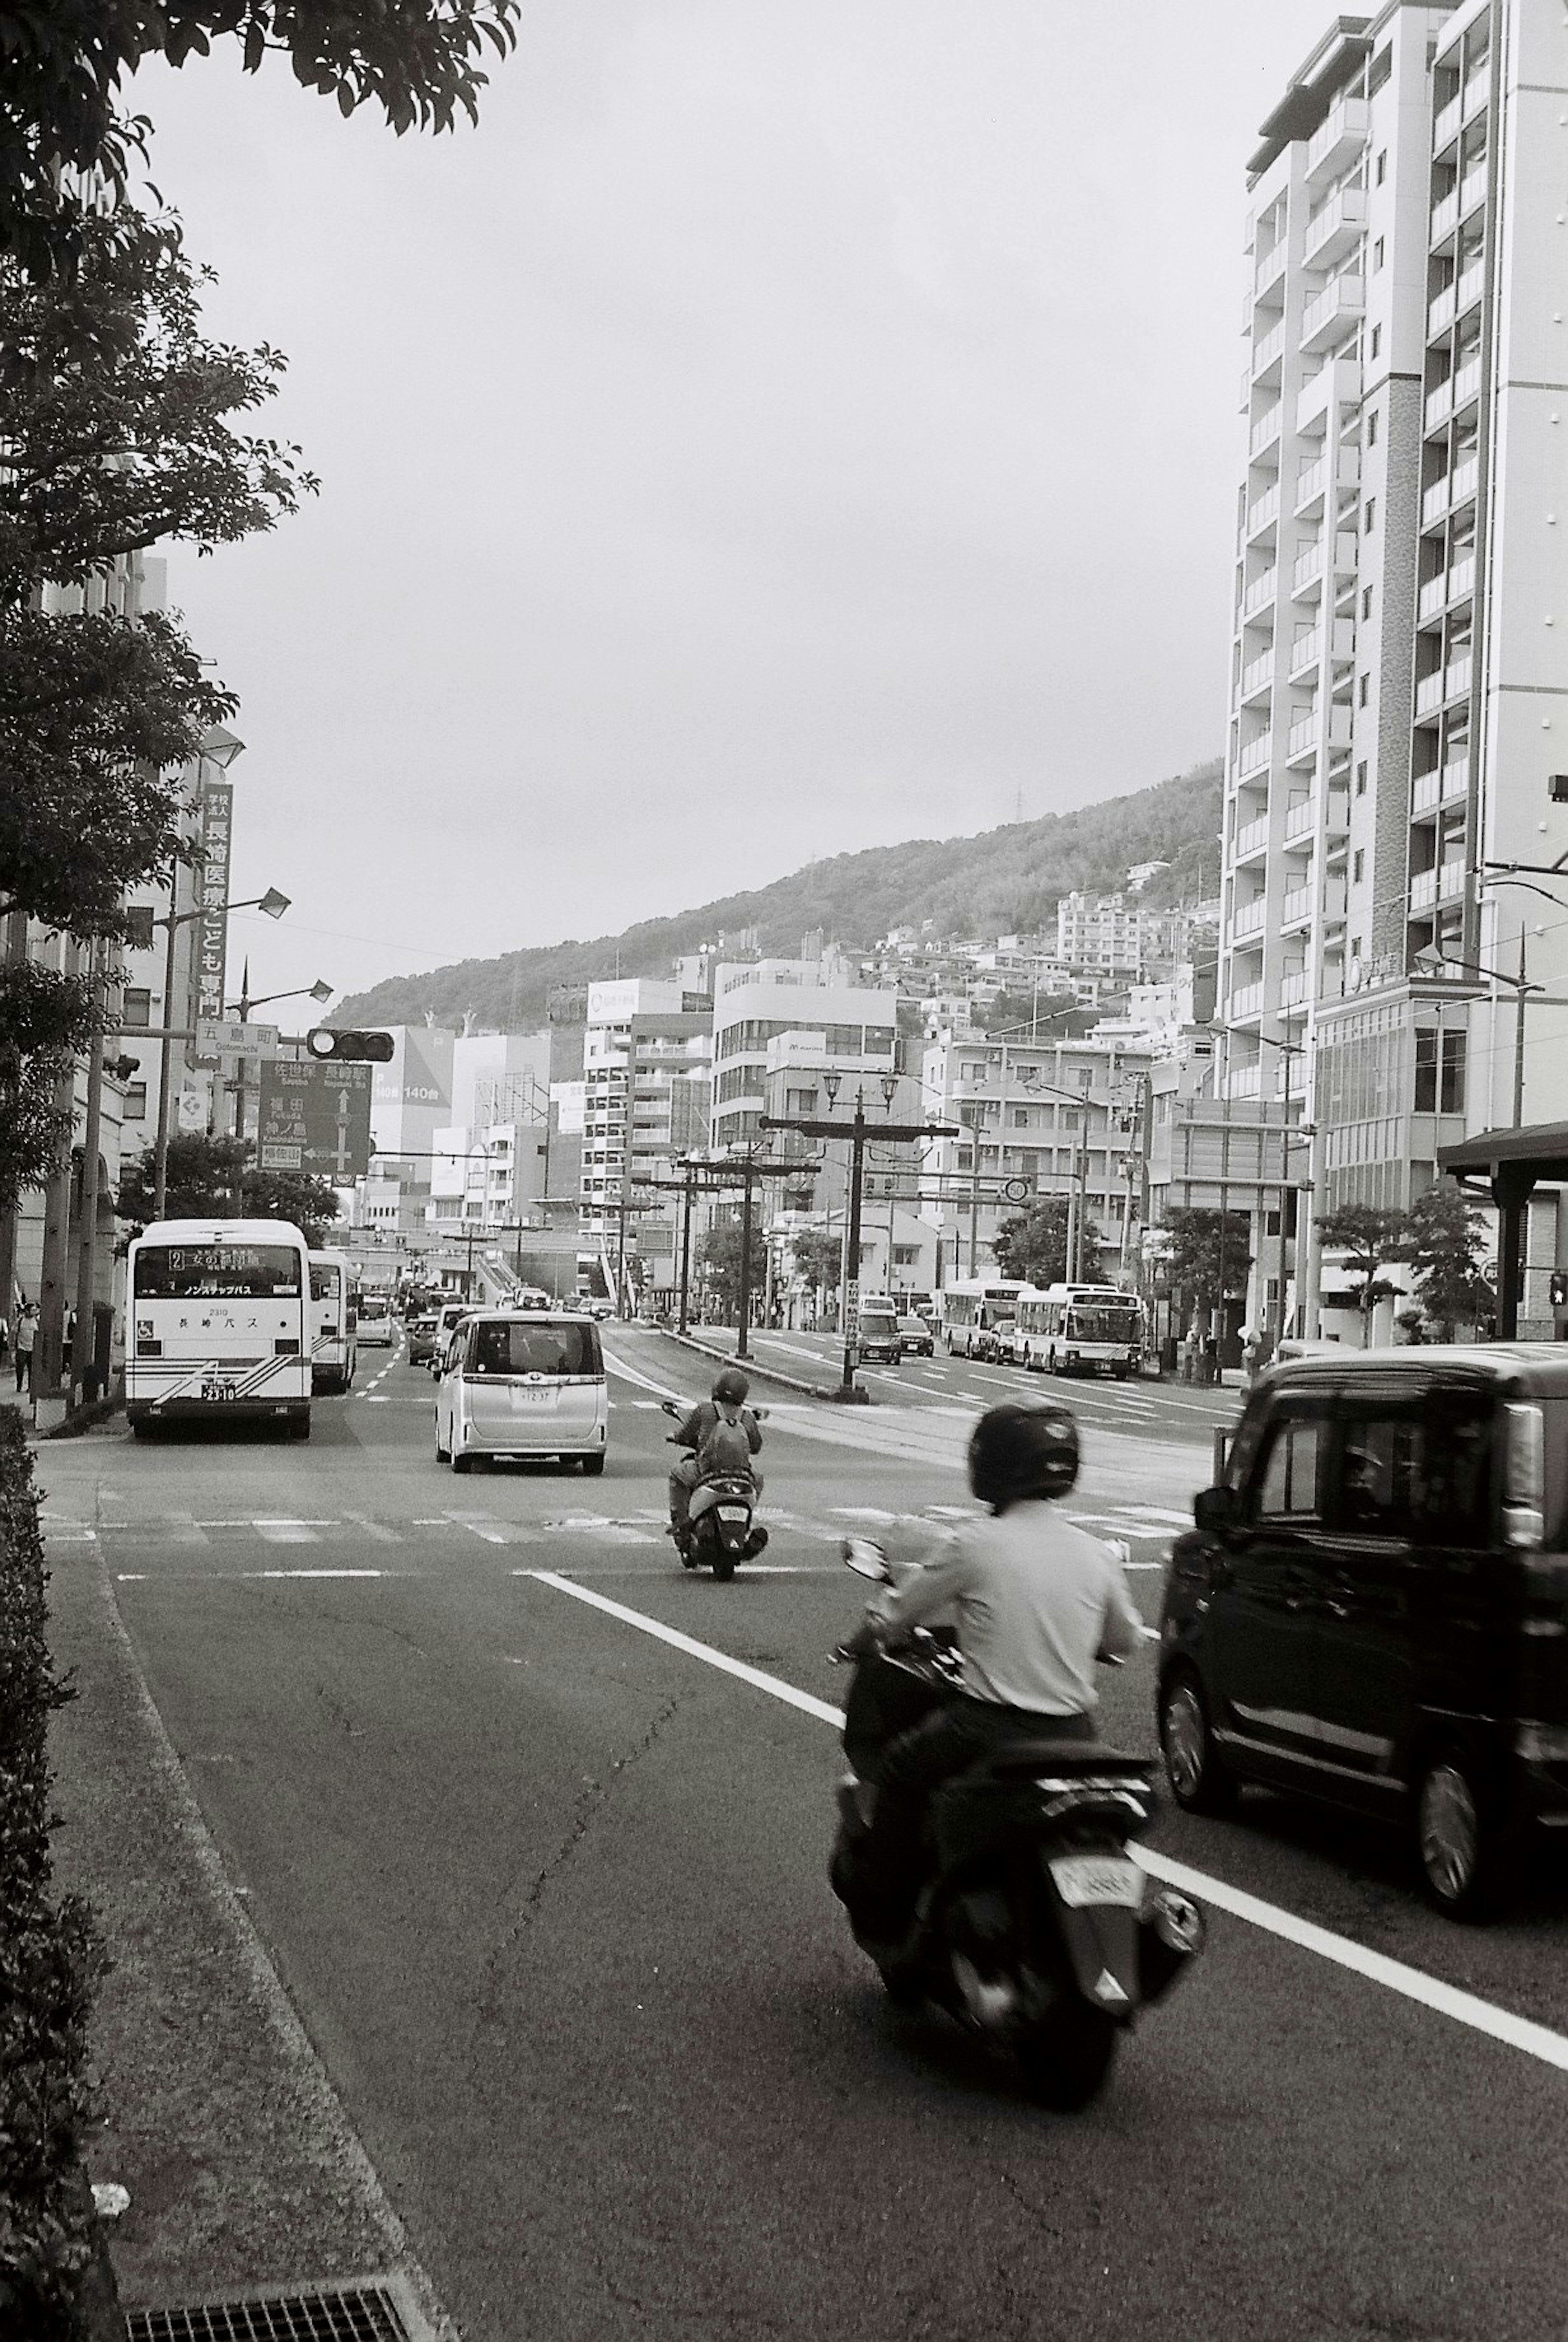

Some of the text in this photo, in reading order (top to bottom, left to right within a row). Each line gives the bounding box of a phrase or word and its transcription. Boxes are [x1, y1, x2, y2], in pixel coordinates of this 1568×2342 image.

[204, 1027, 271, 1044] 五島町
[275, 1063, 316, 1077] 佐世保
[377, 1074, 384, 1083] P
[405, 1087, 439, 1100] 140台
[271, 1097, 303, 1111] 福田
[172, 1252, 180, 1268] 2
[185, 1286, 252, 1295] ノンステップバス
[180, 1319, 257, 1328] 長崎バス
